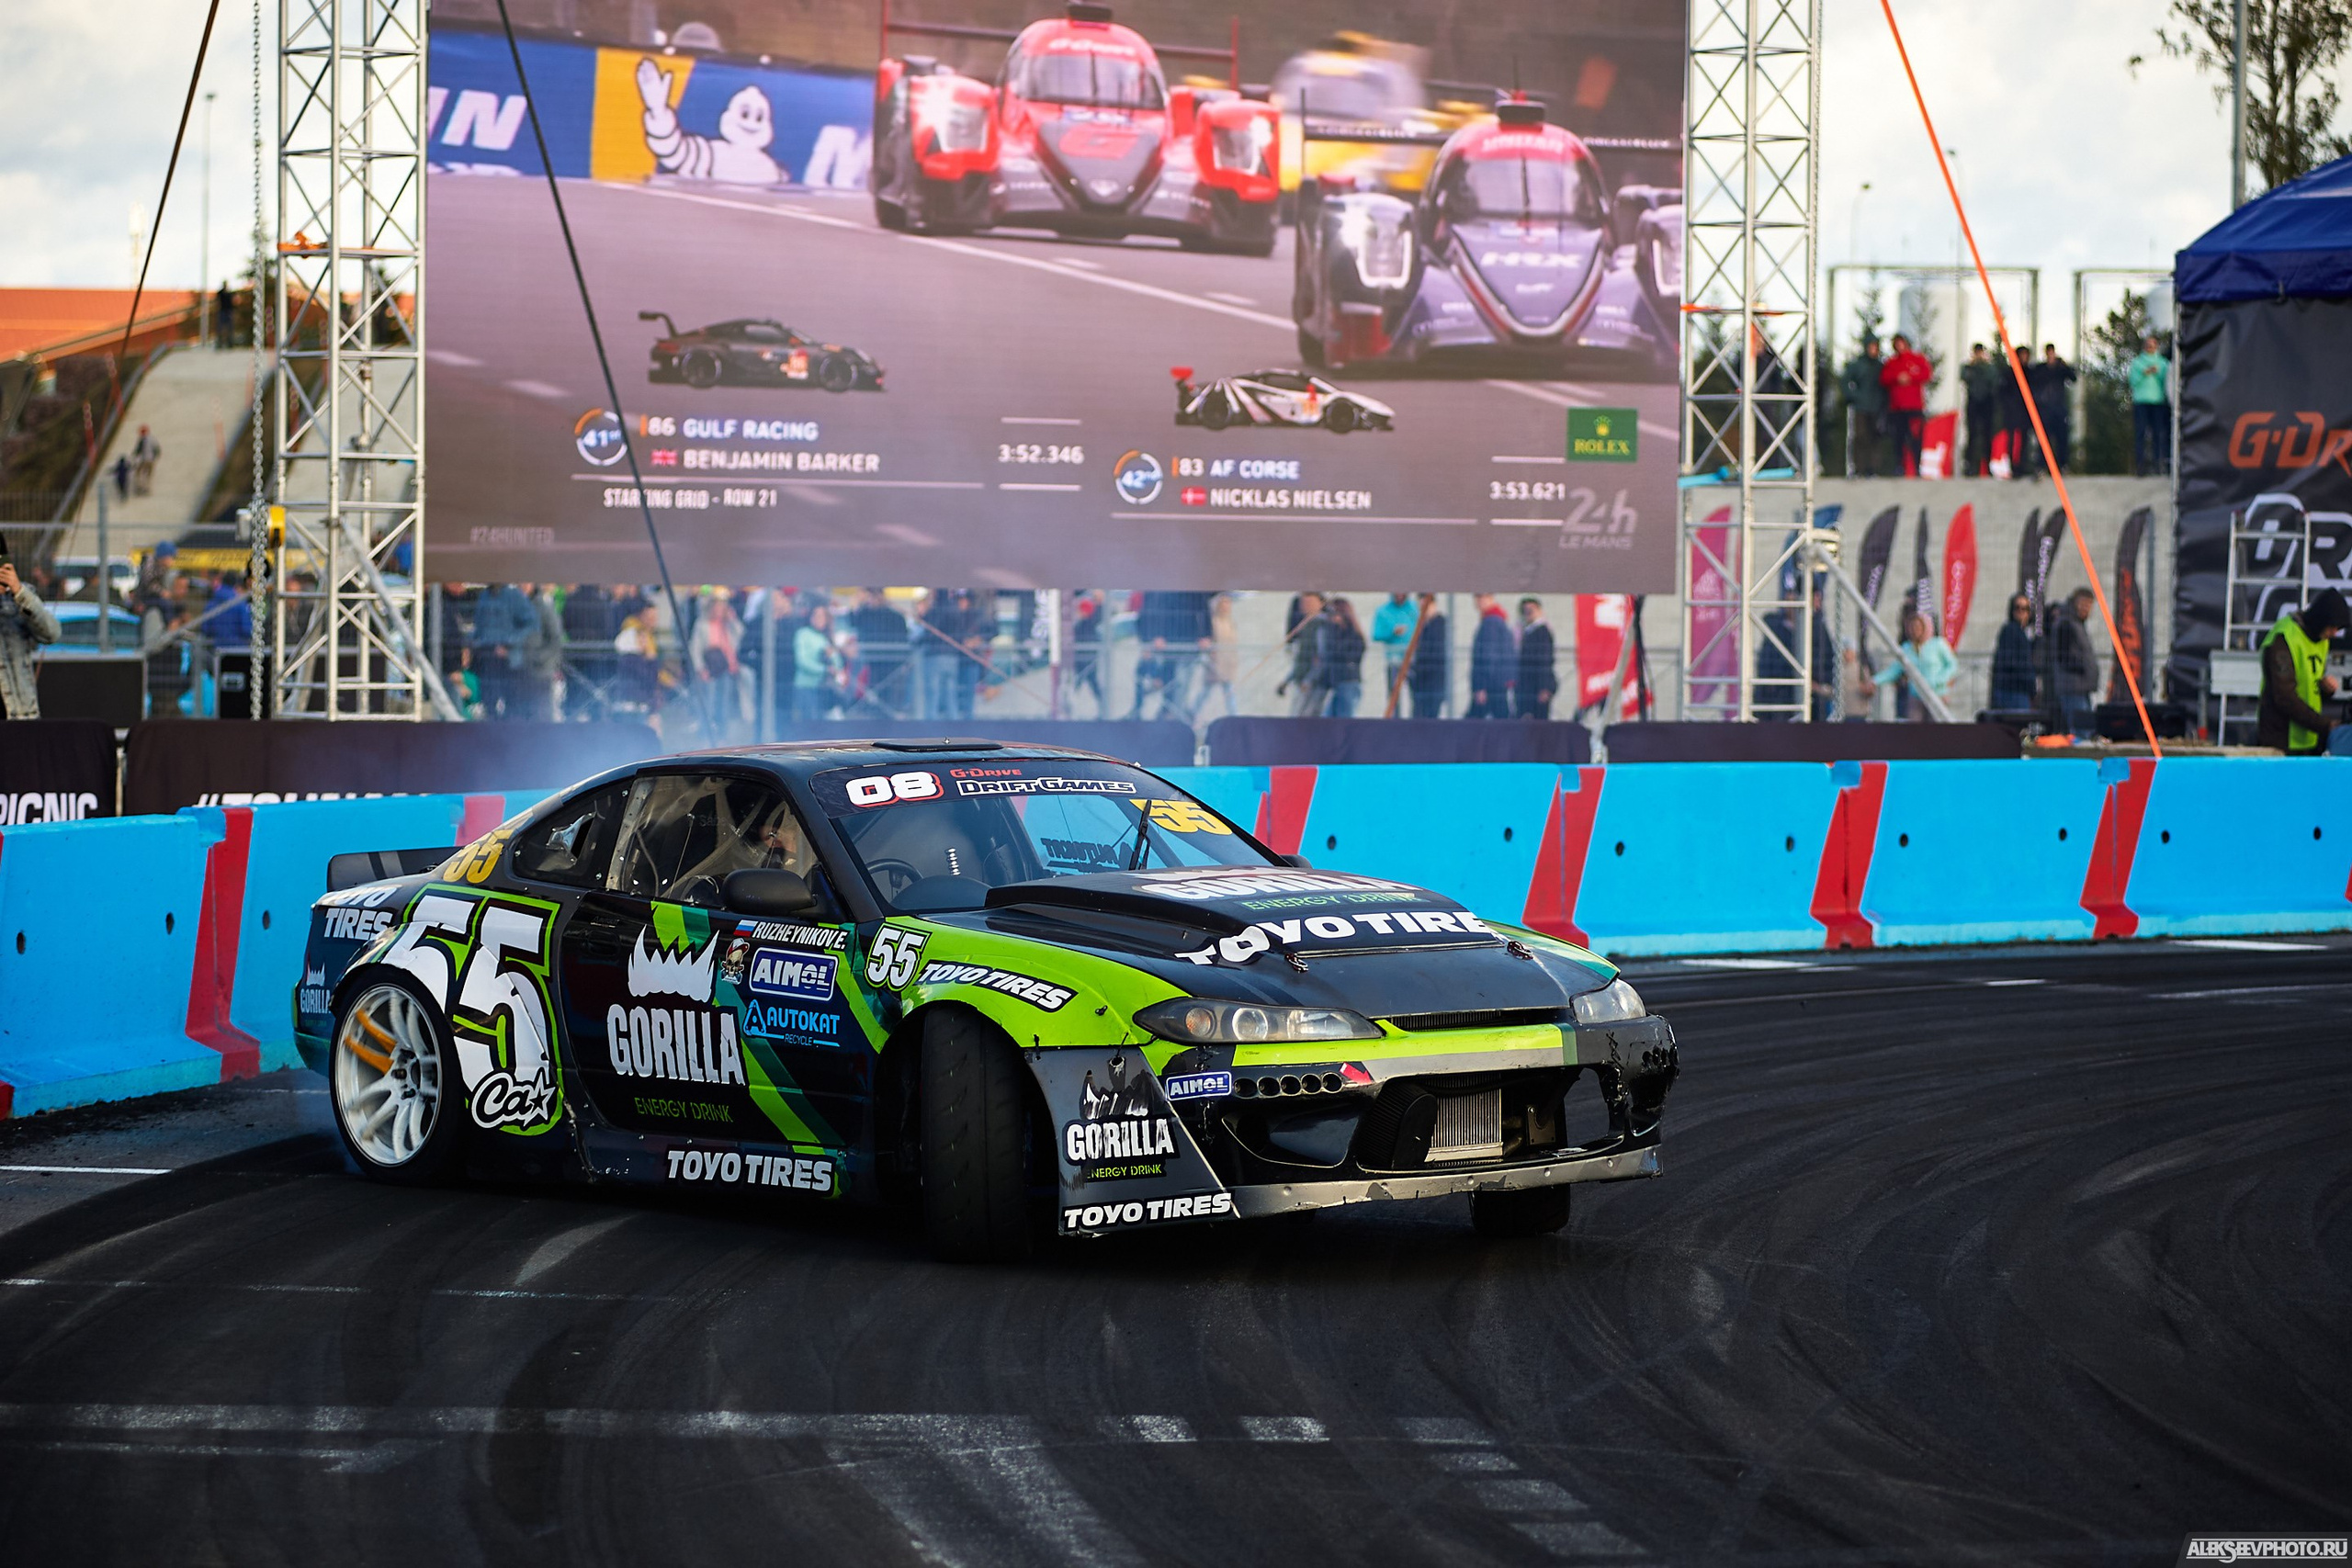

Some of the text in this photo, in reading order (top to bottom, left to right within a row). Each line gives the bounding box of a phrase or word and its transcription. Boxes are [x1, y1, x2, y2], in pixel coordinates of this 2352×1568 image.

[648, 416, 819, 442] 86 GULF RACING
[999, 444, 1084, 465] 3:52.346
[1573, 438, 1631, 456] ROLEX
[683, 449, 880, 473] BENJAMIN BARKER
[1179, 457, 1300, 479] 83 AF CORSE
[603, 488, 673, 509] STARING
[675, 490, 710, 509] GRID
[723, 488, 756, 507] ROW
[758, 489, 778, 507] 21
[1210, 488, 1372, 511] NICKLAS NIELSEN
[1489, 480, 1566, 501] 3:53.621
[844, 771, 944, 807] 08
[1129, 798, 1233, 836] 55
[442, 829, 514, 884] 55
[1140, 872, 1424, 900] GORILLA
[1242, 892, 1421, 910] ENERGY DRINK
[323, 908, 393, 941] TIRES
[1175, 912, 1498, 965] TOYO TIRE
[867, 927, 926, 987] 55
[752, 958, 831, 991] AIMOL
[919, 963, 1072, 1010] TOYO TIRES
[766, 1007, 841, 1034] AUTOKAT
[606, 1003, 746, 1087] GORILLA
[784, 1033, 813, 1046] RECYCLE
[1170, 1077, 1229, 1097] AIMOL
[634, 1097, 734, 1122] ENERGY DRINK
[1066, 1118, 1175, 1161] GORILLA
[667, 1149, 832, 1191] TOYO TIRES
[1130, 1164, 1162, 1177] DRINK
[1064, 1192, 1232, 1229] TOYO TIRES
